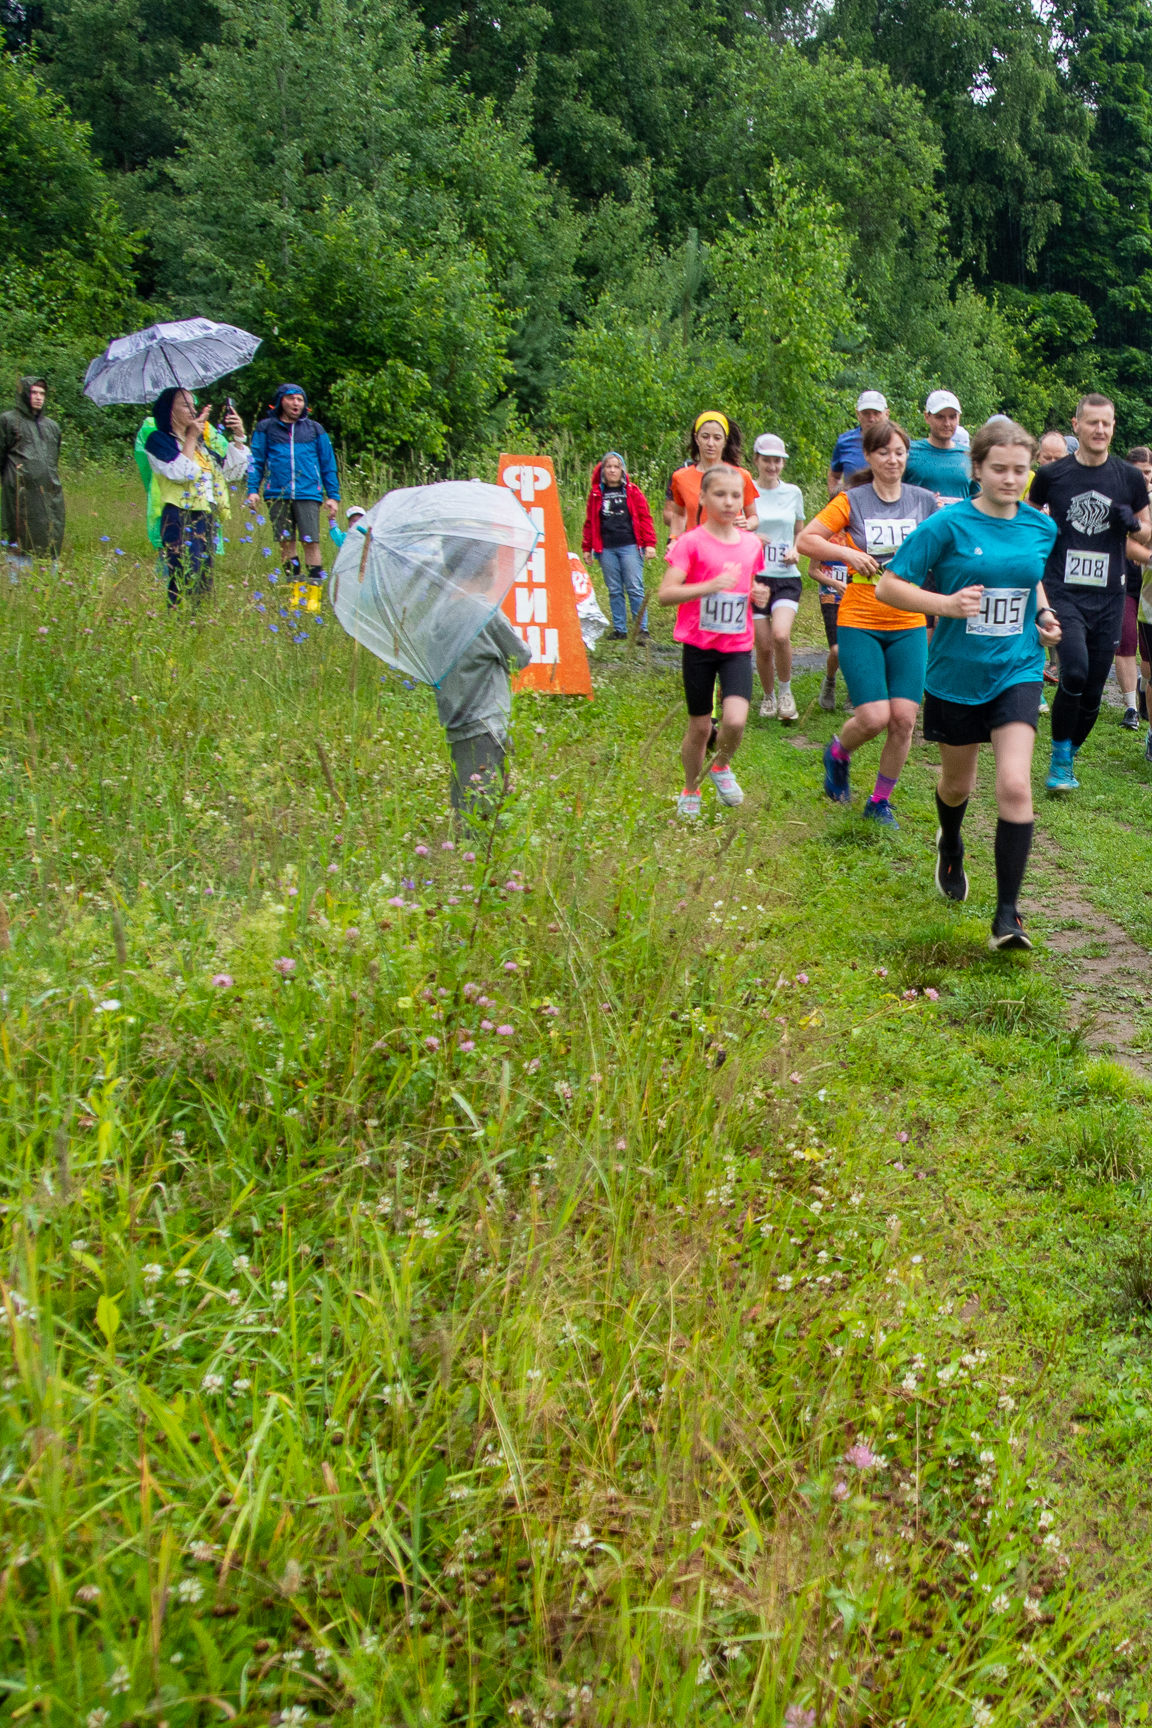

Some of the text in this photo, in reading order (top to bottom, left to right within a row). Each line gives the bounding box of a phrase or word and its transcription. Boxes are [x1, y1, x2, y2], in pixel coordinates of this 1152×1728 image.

[763, 546, 786, 563] 03
[1070, 557, 1104, 578] 208
[706, 598, 744, 623] 402
